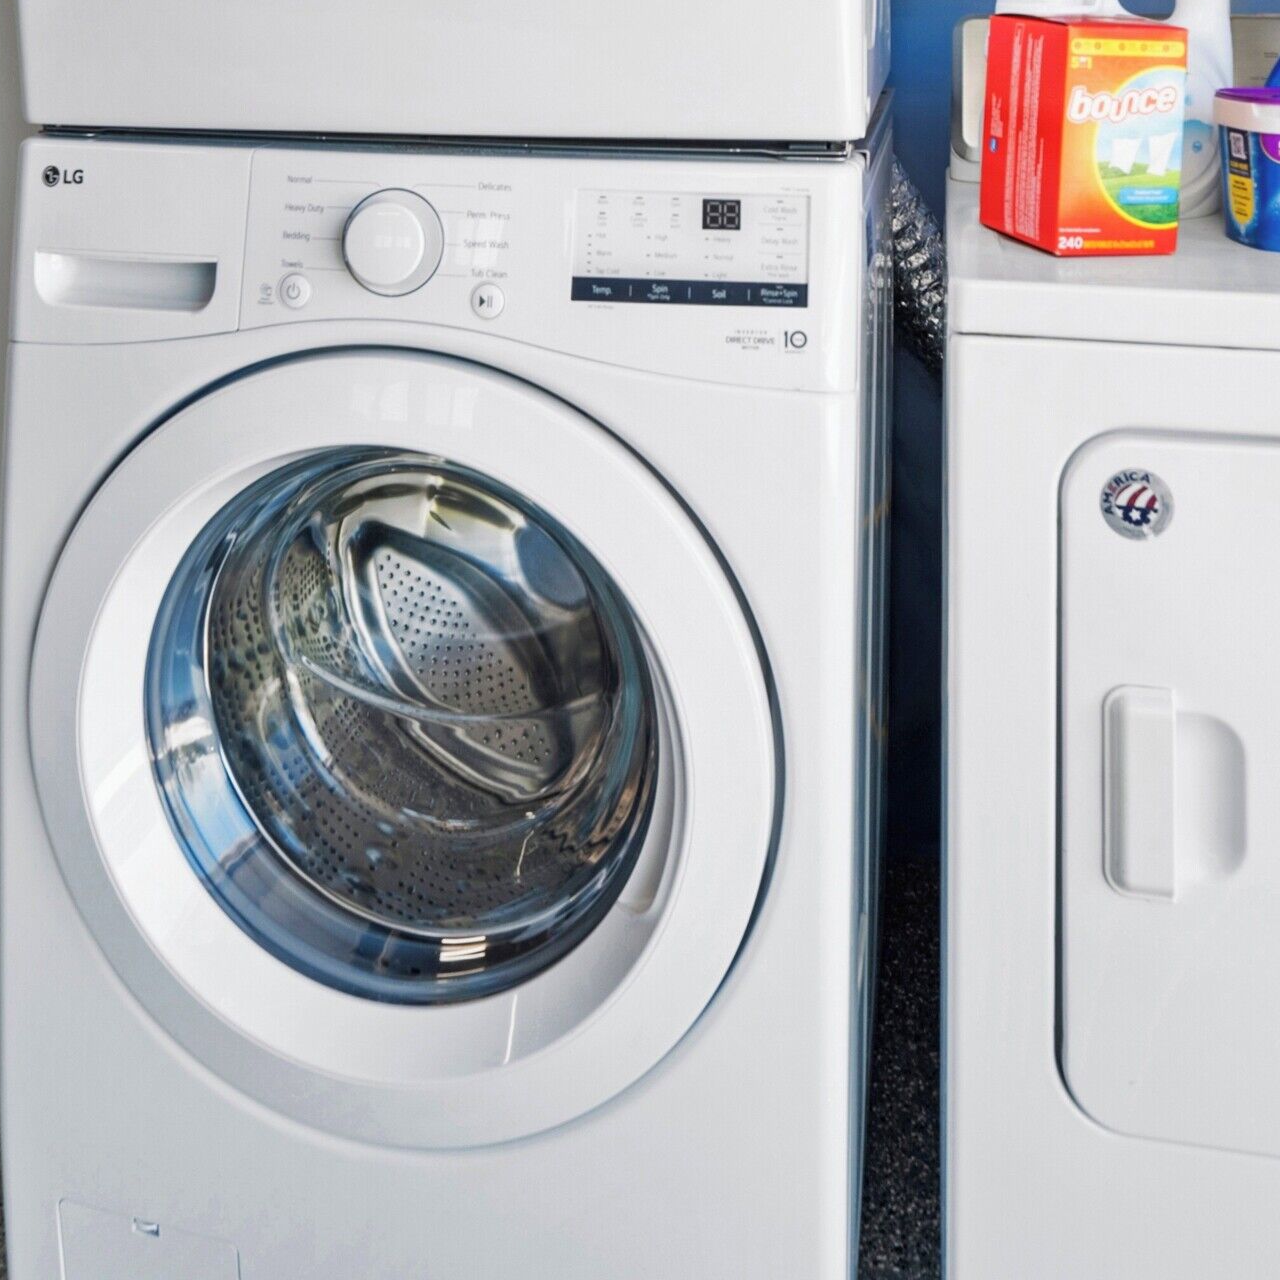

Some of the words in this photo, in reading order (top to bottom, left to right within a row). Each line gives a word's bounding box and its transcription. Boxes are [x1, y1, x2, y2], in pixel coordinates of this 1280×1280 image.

[1069, 85, 1177, 122] bounce
[63, 169, 84, 184] LG
[287, 175, 312, 184] Normal
[478, 181, 512, 191] Delicates
[284, 203, 306, 213] Heavy
[307, 203, 324, 213] Duty
[489, 211, 510, 220] Press
[282, 230, 311, 242] Bedding
[489, 239, 509, 248] Wash
[1057, 236, 1083, 249] 240
[486, 269, 508, 278] Clean
[592, 284, 612, 296] Temp.
[652, 283, 668, 294] Spin
[712, 289, 727, 299] Soil
[1103, 471, 1151, 515] AMERICA
